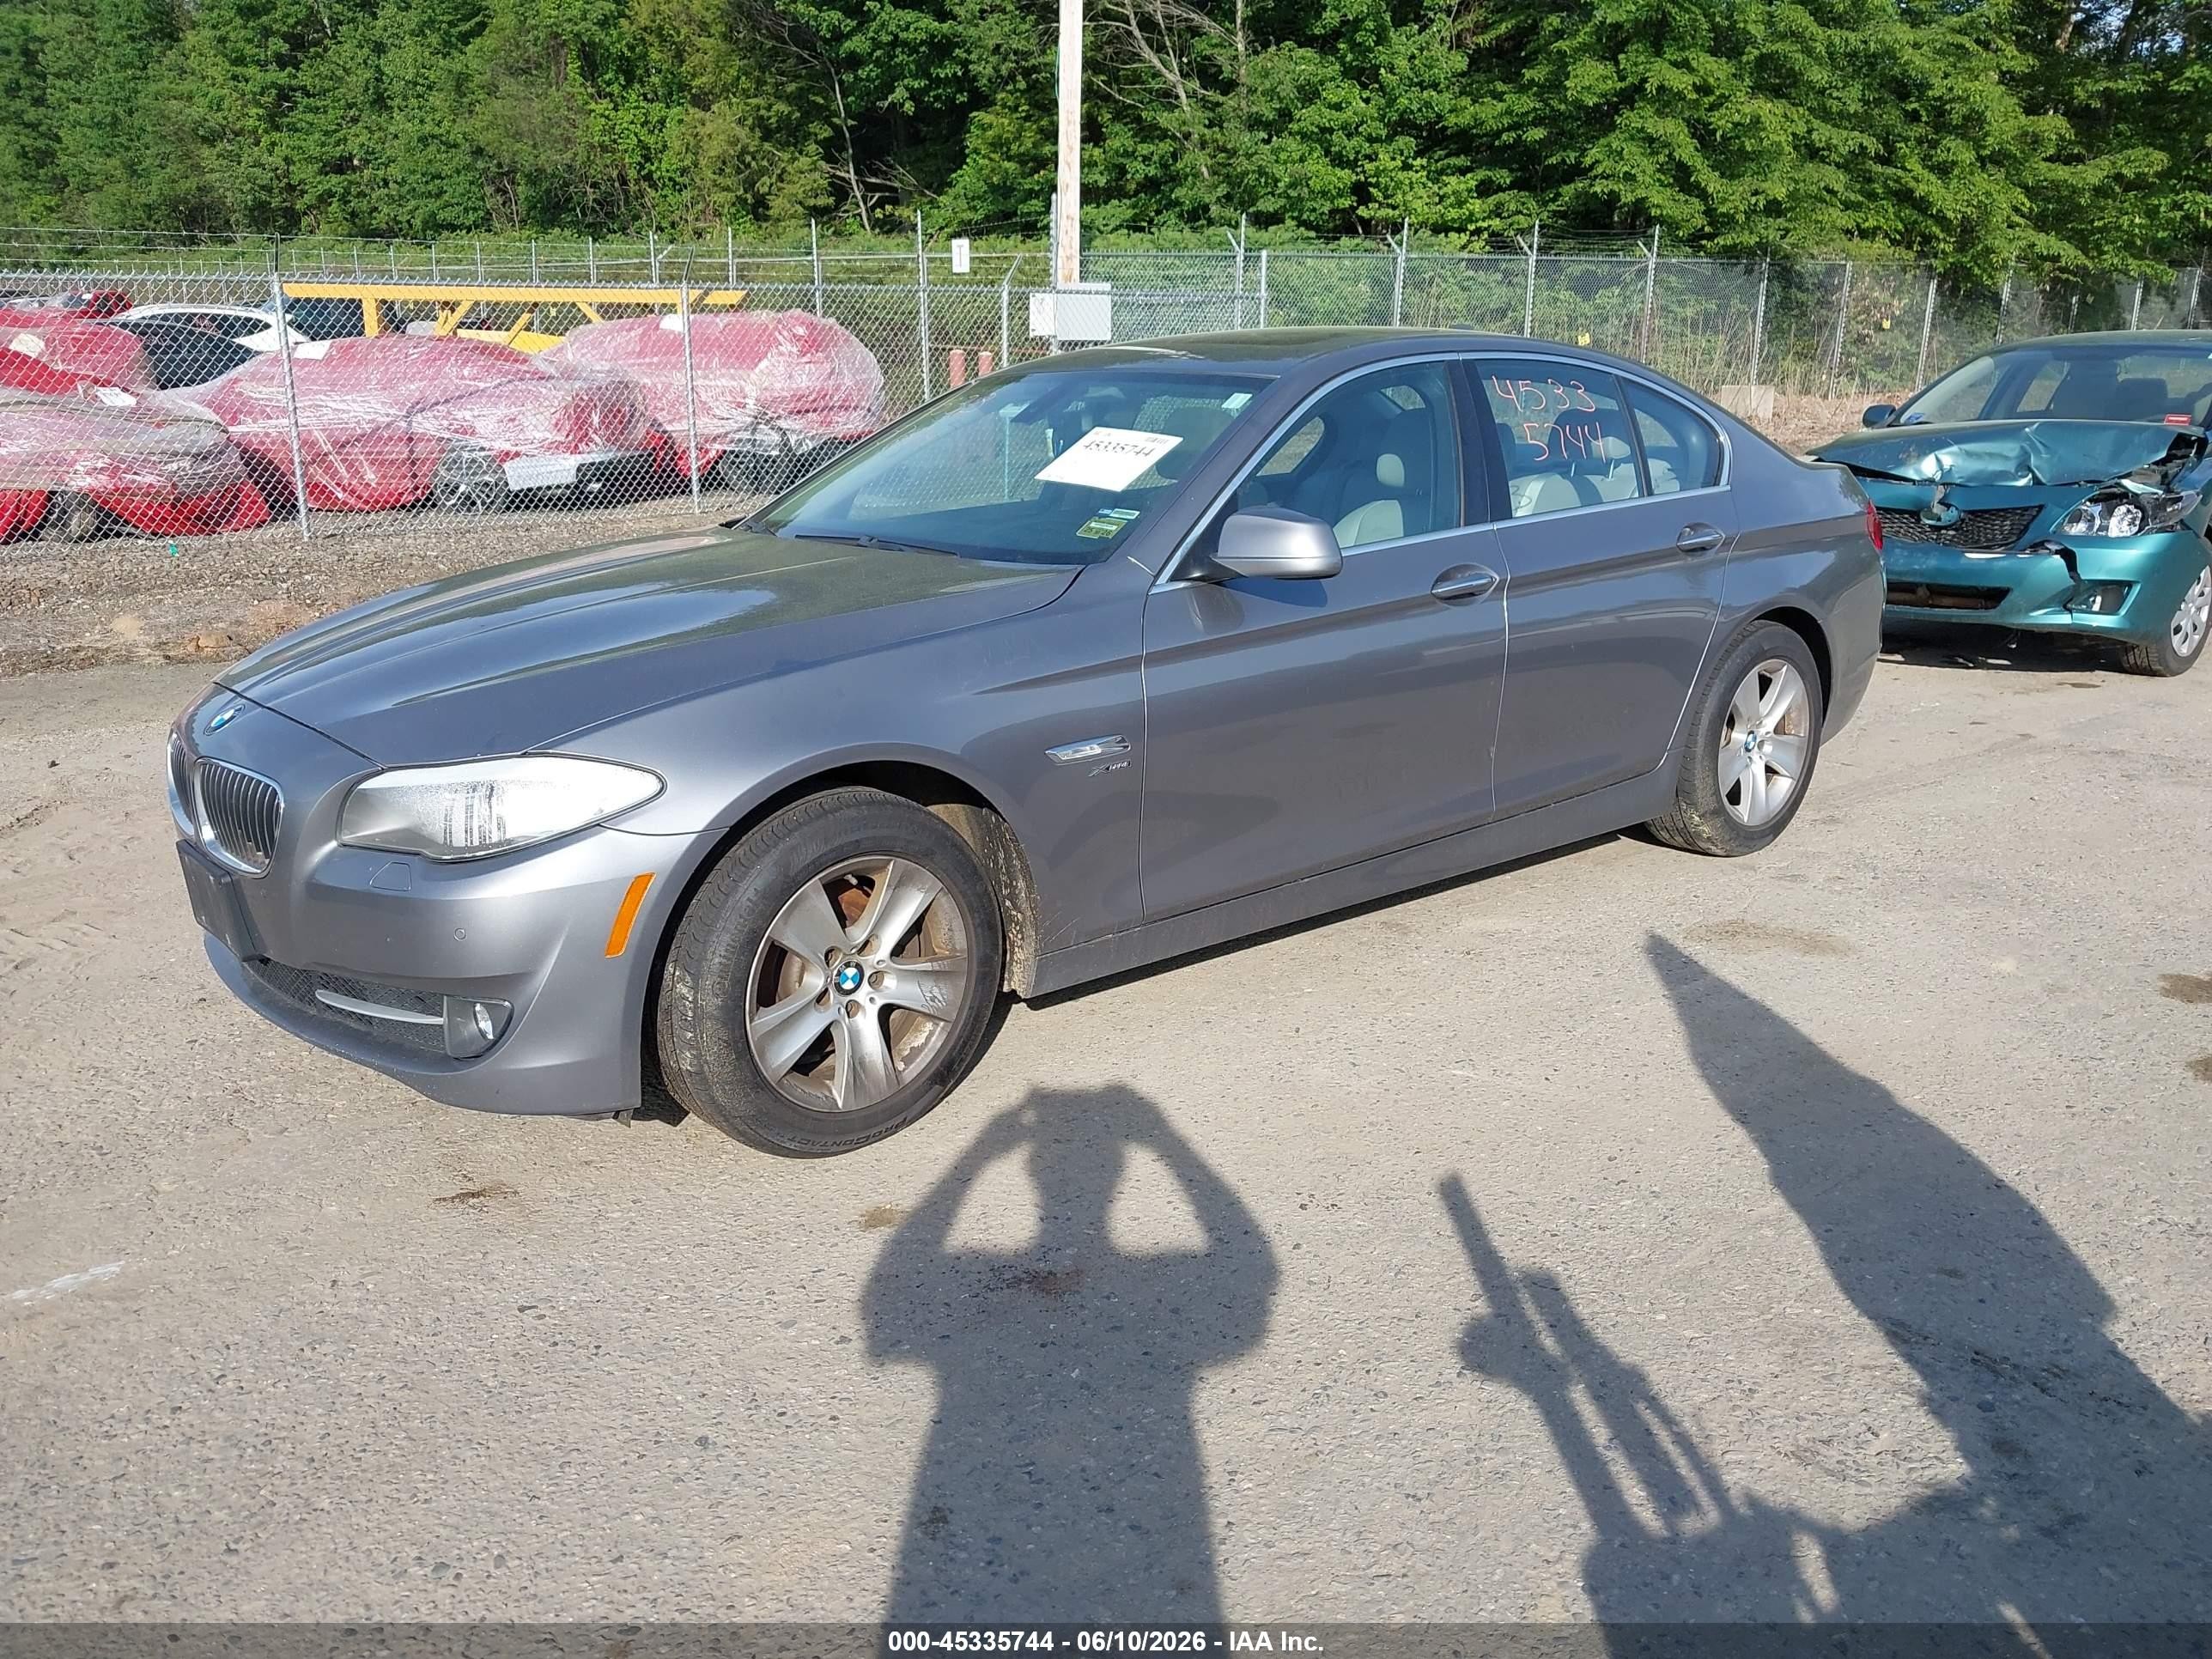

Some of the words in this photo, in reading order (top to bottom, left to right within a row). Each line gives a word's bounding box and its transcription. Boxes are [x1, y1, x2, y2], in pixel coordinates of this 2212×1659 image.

[1492, 374, 1595, 412] 4533
[1083, 440, 1157, 457] 45335744
[1522, 421, 1607, 462] 5744
